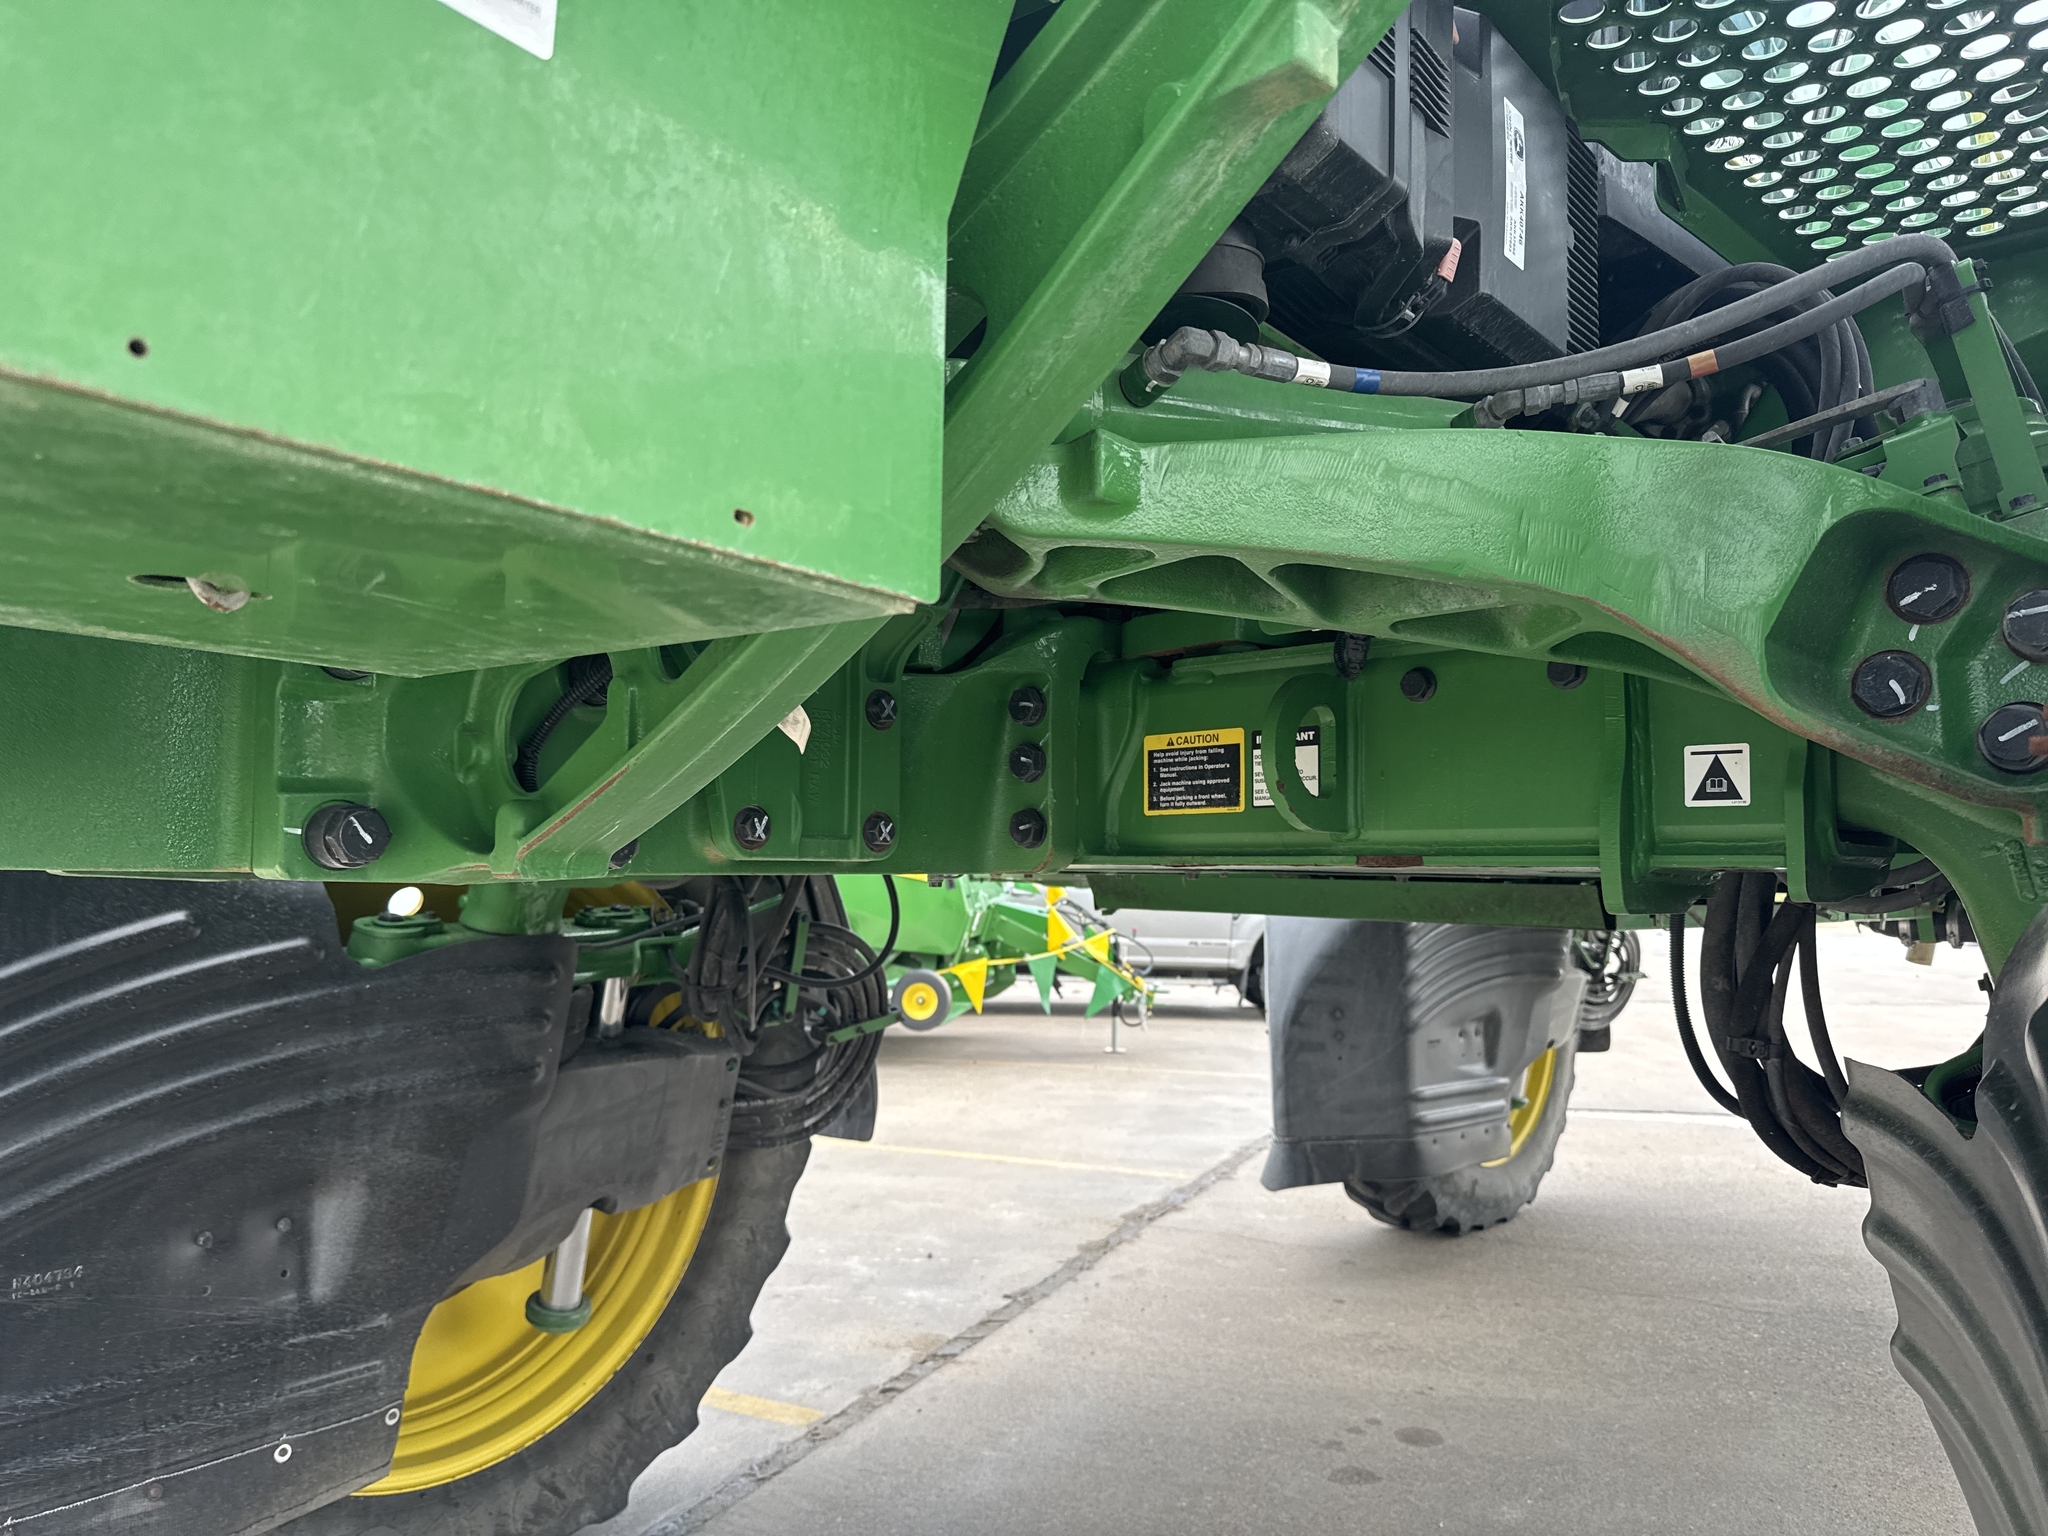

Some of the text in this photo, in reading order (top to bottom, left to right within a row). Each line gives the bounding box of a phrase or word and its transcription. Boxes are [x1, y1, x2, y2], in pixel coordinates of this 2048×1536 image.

[1176, 733, 1219, 746] CAUTION
[1180, 749, 1194, 757] injury
[1207, 777, 1230, 785] approved
[1175, 794, 1193, 802] jacking
[1175, 800, 1185, 808] fully
